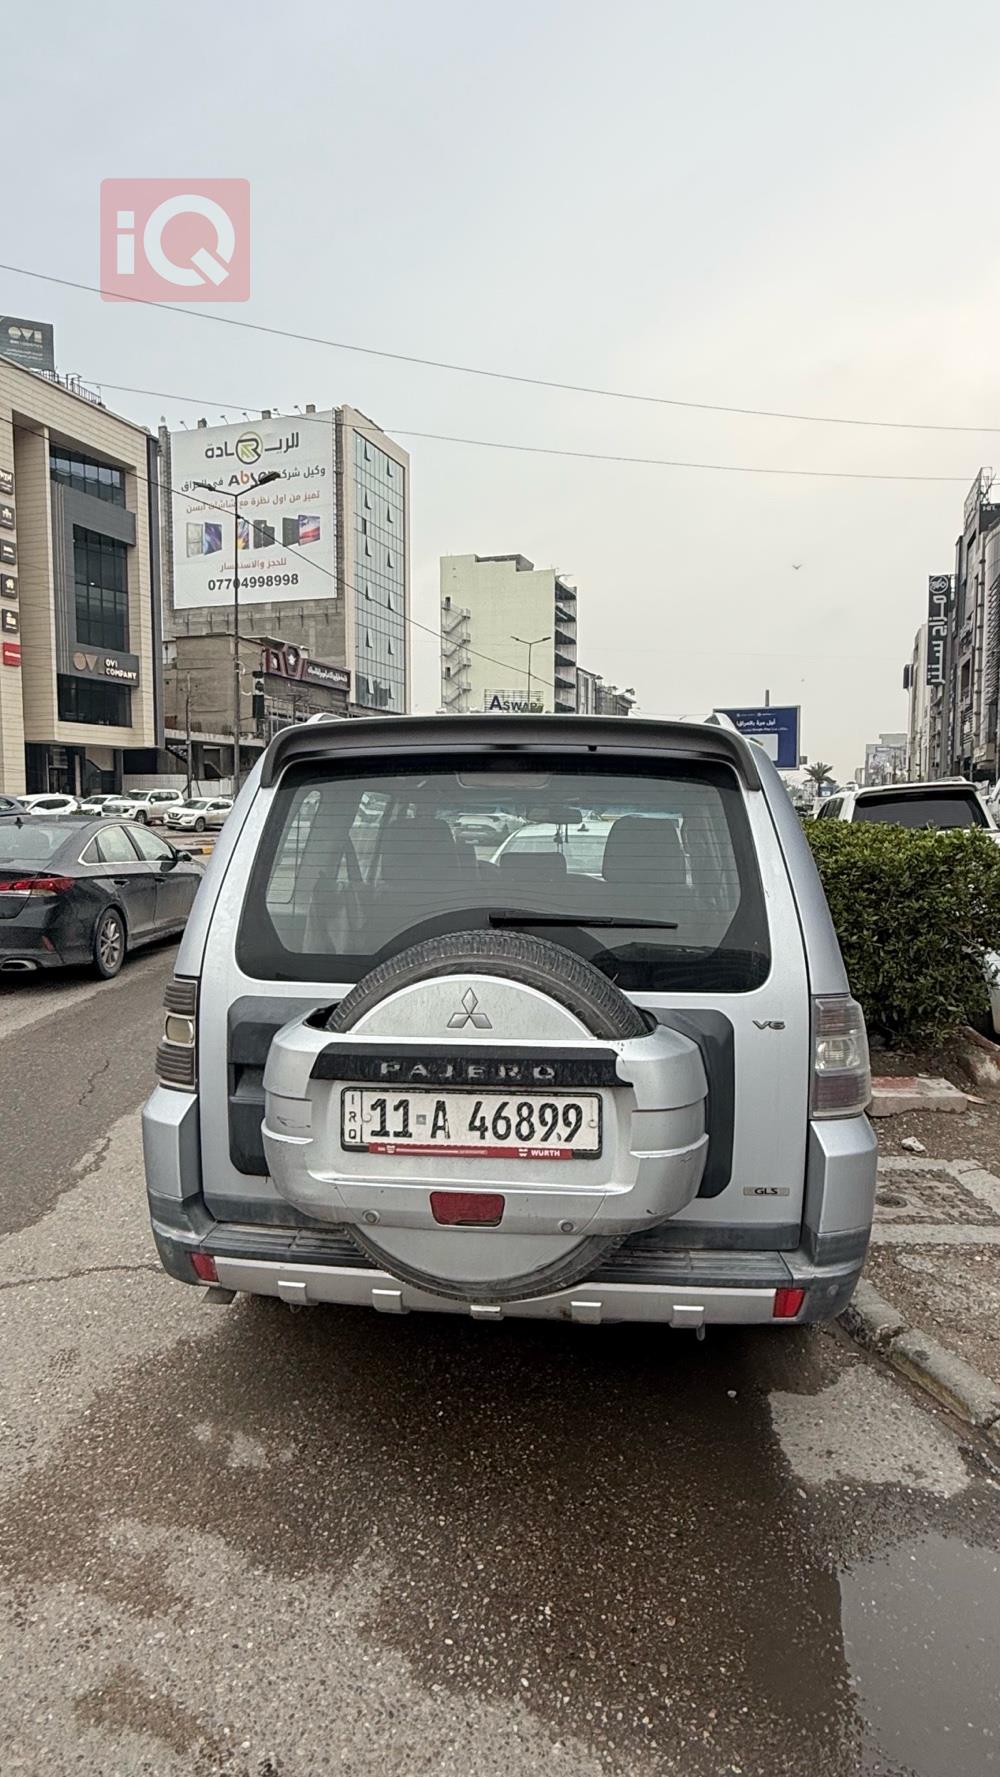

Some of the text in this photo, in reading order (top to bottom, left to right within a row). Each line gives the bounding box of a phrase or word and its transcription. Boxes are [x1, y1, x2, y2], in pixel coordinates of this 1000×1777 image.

[279, 467, 301, 480] شرك
[303, 464, 326, 478] وكيل
[289, 494, 301, 504] من
[219, 560, 265, 573] والاستسار
[105, 658, 118, 668] OVI
[105, 668, 137, 680] COMPANY
[752, 1020, 786, 1030] V6
[380, 1061, 556, 1080] PAJERO
[370, 1098, 583, 1143] 11 A 46899
[754, 1187, 778, 1195] GLS
